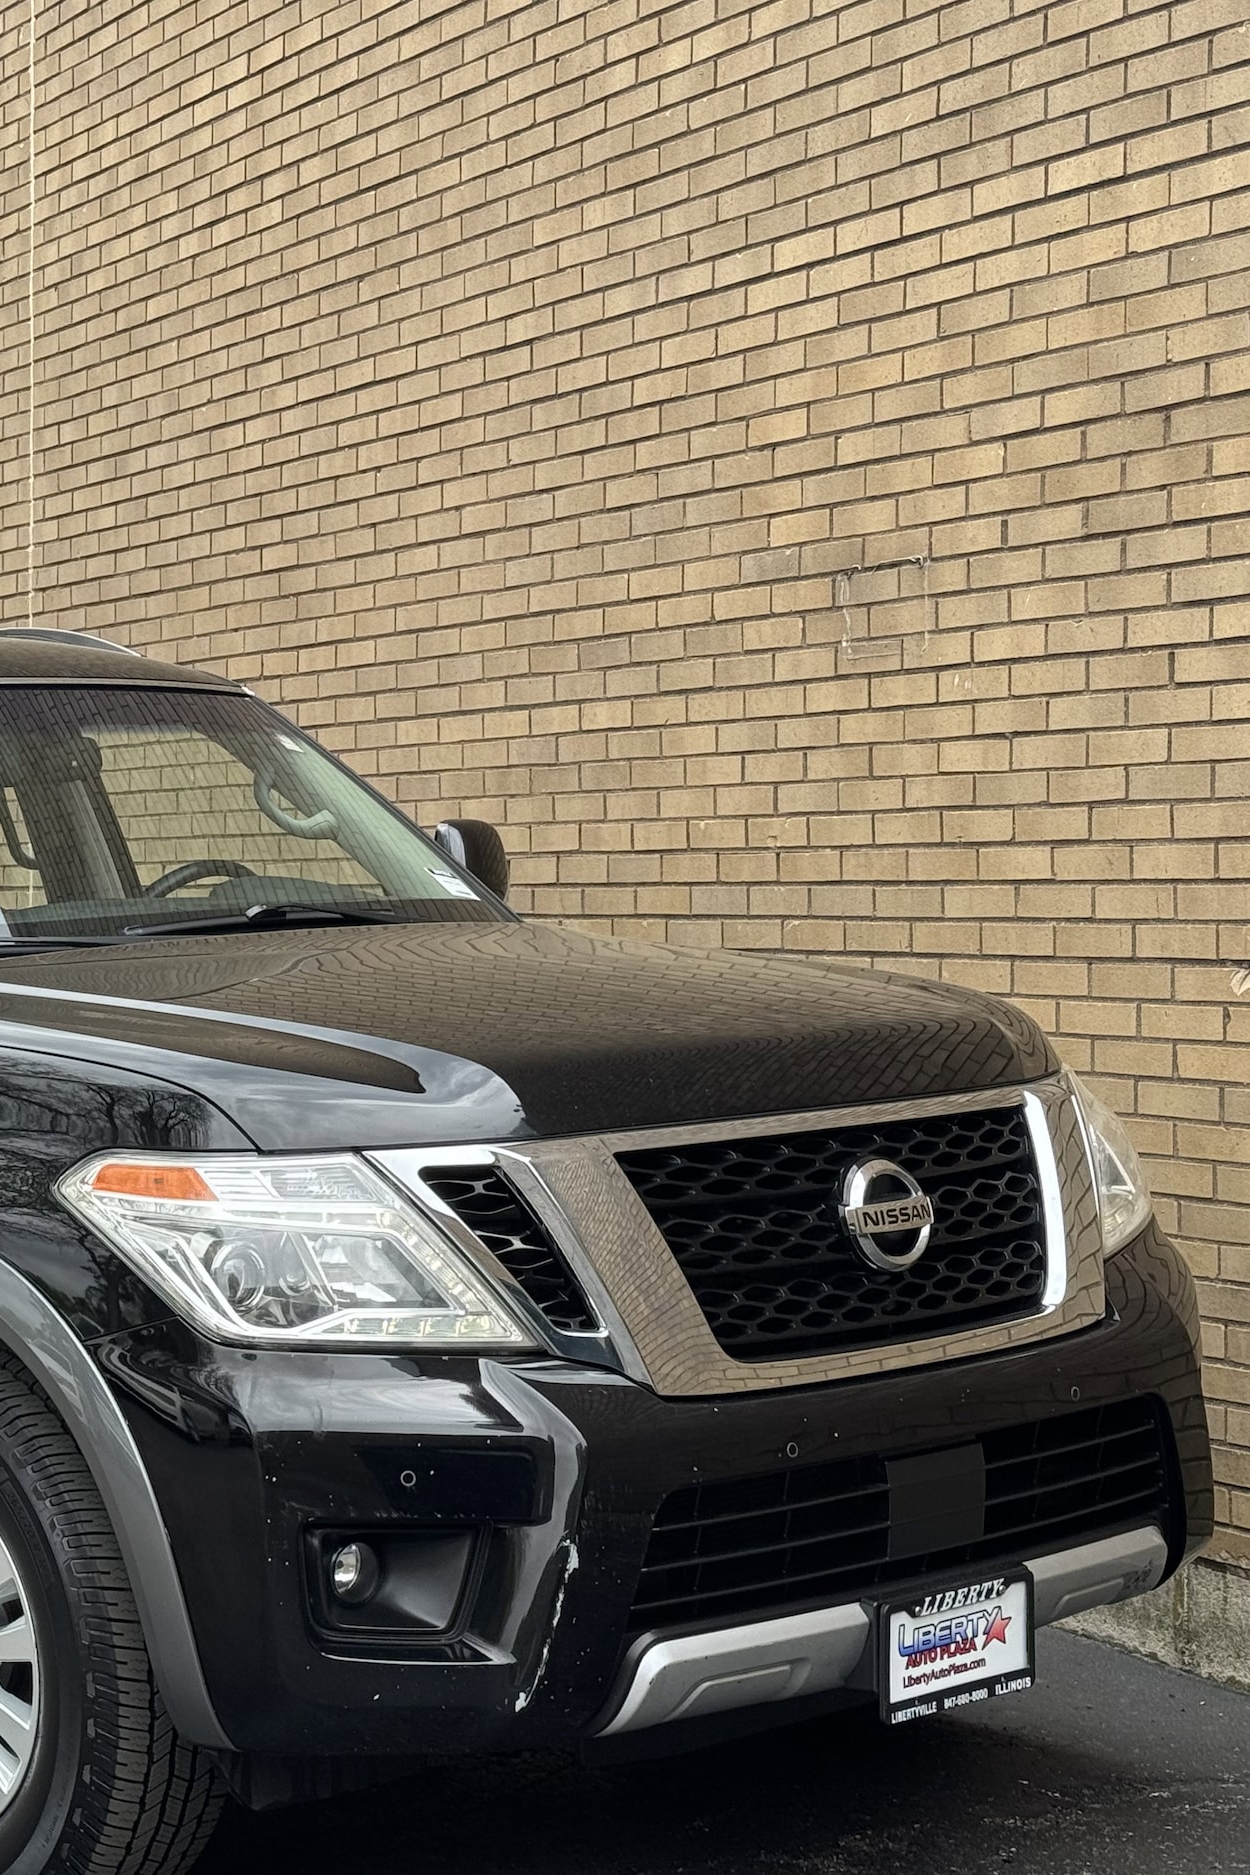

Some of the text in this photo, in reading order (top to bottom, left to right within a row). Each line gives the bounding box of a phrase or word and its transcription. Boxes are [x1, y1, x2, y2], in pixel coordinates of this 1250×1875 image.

[862, 1203, 930, 1228] NISSAN
[921, 1578, 1004, 1616] LIBERTY
[899, 1606, 1003, 1657] LIBERTY
[905, 1638, 978, 1670] AUTO PLAZA
[903, 1657, 986, 1688] LibertyAutoPlaza.com
[891, 1701, 937, 1724] LIBERTYVILLE
[995, 1676, 1031, 1695] ILLINOIS
